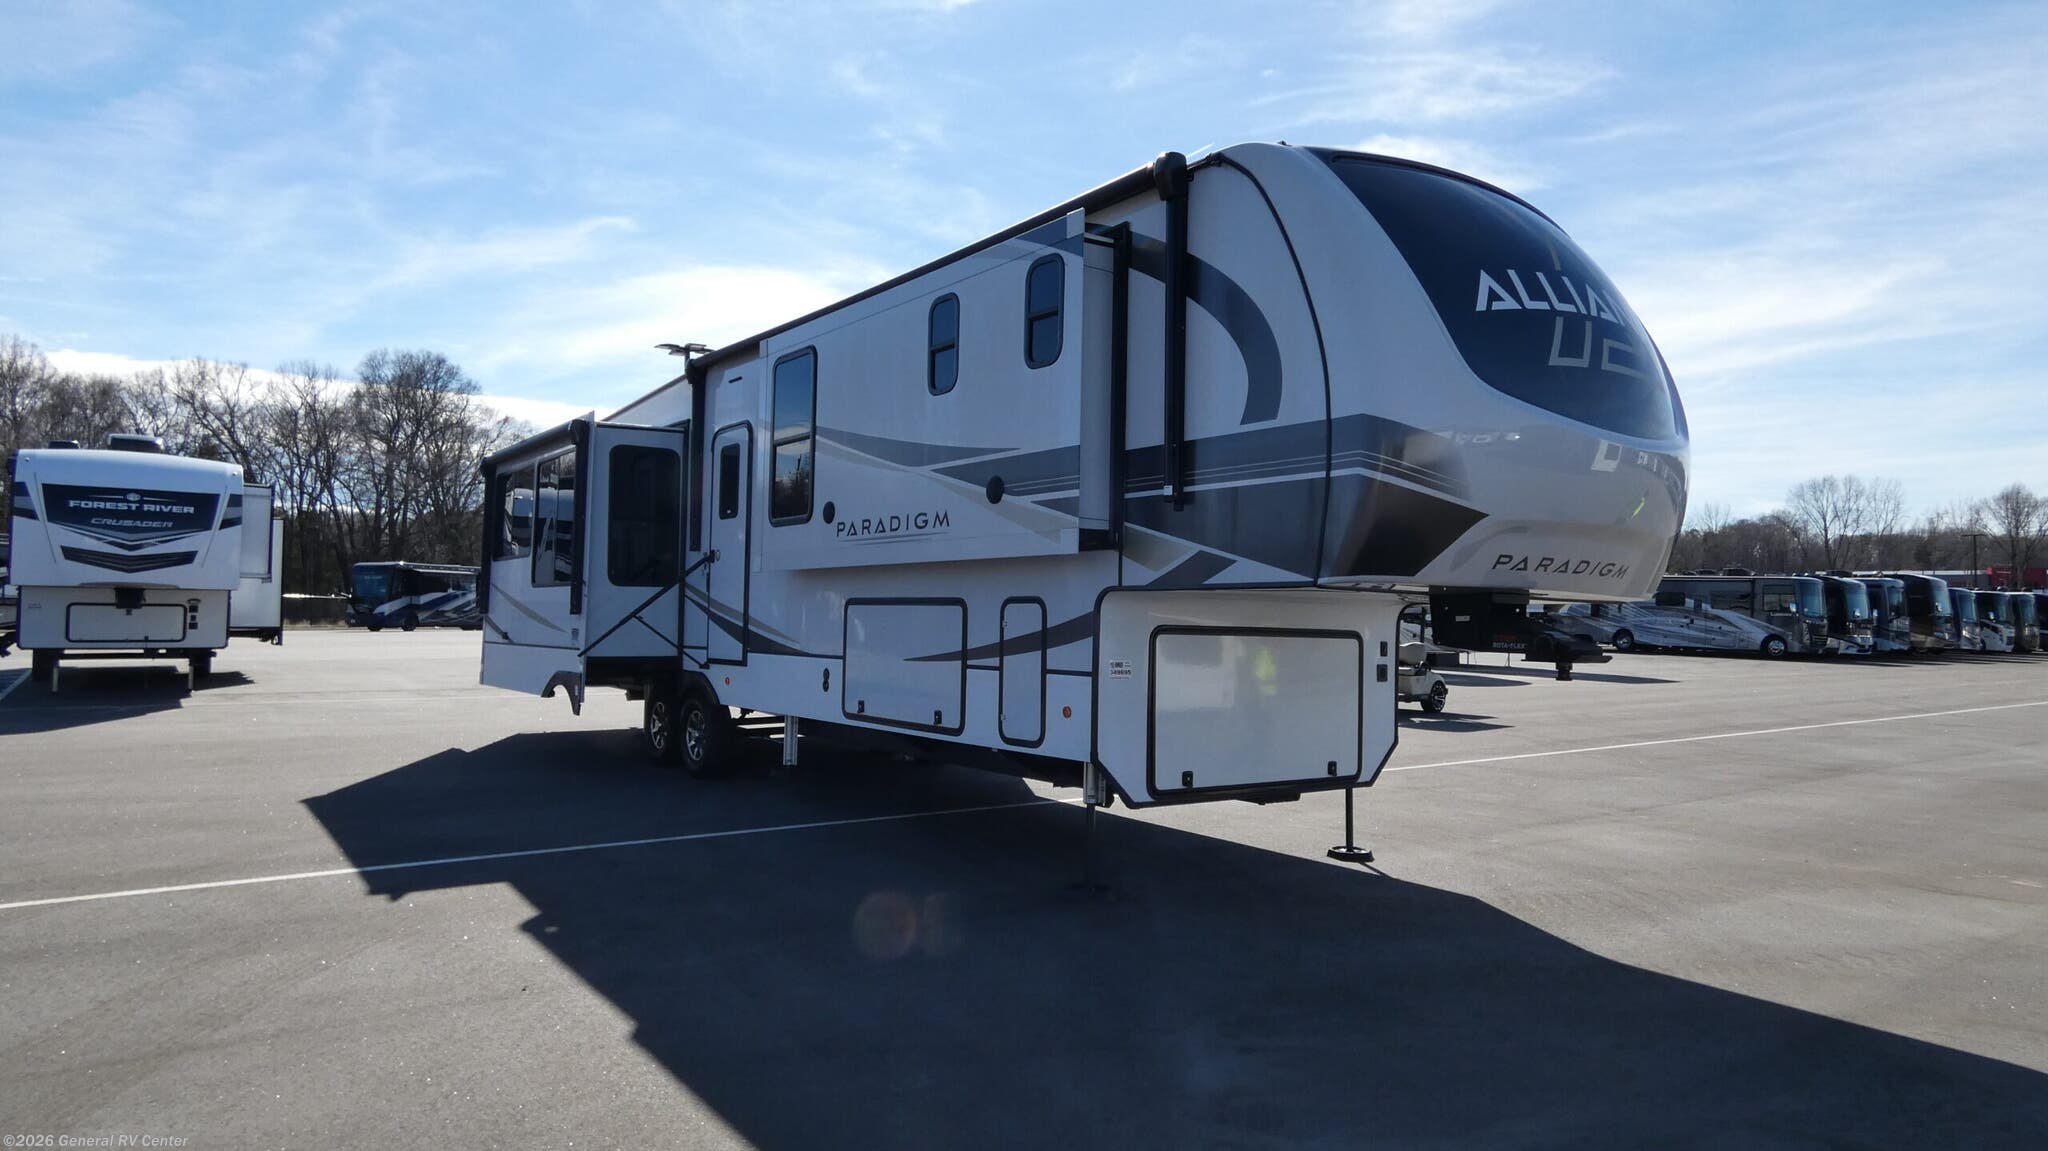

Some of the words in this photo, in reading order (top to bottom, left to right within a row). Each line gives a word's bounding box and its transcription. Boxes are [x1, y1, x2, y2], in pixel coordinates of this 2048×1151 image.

[68, 500, 141, 511] FOREST
[143, 503, 195, 514] RIVER
[90, 517, 174, 528] CRUSADER
[836, 509, 950, 538] PARADIGM
[1491, 553, 1630, 580] PARADIGM
